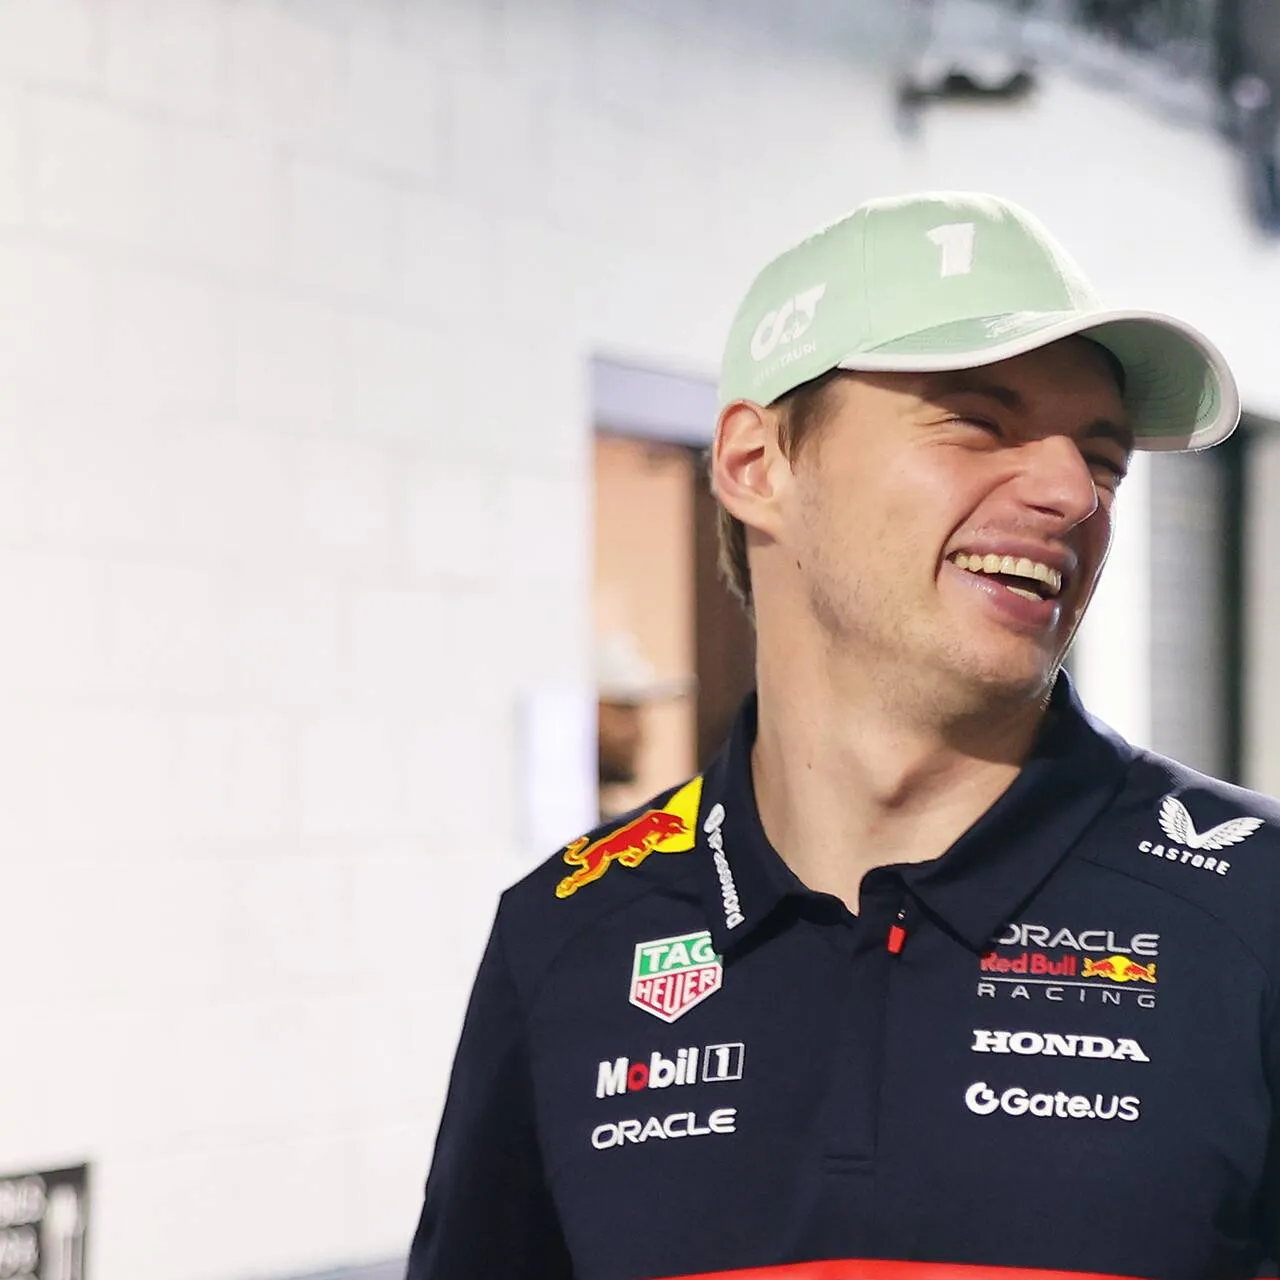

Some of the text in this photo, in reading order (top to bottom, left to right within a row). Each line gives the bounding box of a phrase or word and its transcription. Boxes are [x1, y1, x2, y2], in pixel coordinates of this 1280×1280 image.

[925, 223, 975, 278] 1
[1138, 840, 1231, 876] CASTORE
[642, 935, 720, 972] TAG
[995, 922, 1160, 956] ORACLE
[635, 966, 716, 1016] HEUER
[976, 983, 1156, 1009] RACING
[971, 1030, 1150, 1062] HONDA
[596, 1047, 699, 1098] Mobil
[1000, 1087, 1140, 1122] Gate.US
[591, 1108, 738, 1150] ORACLE
